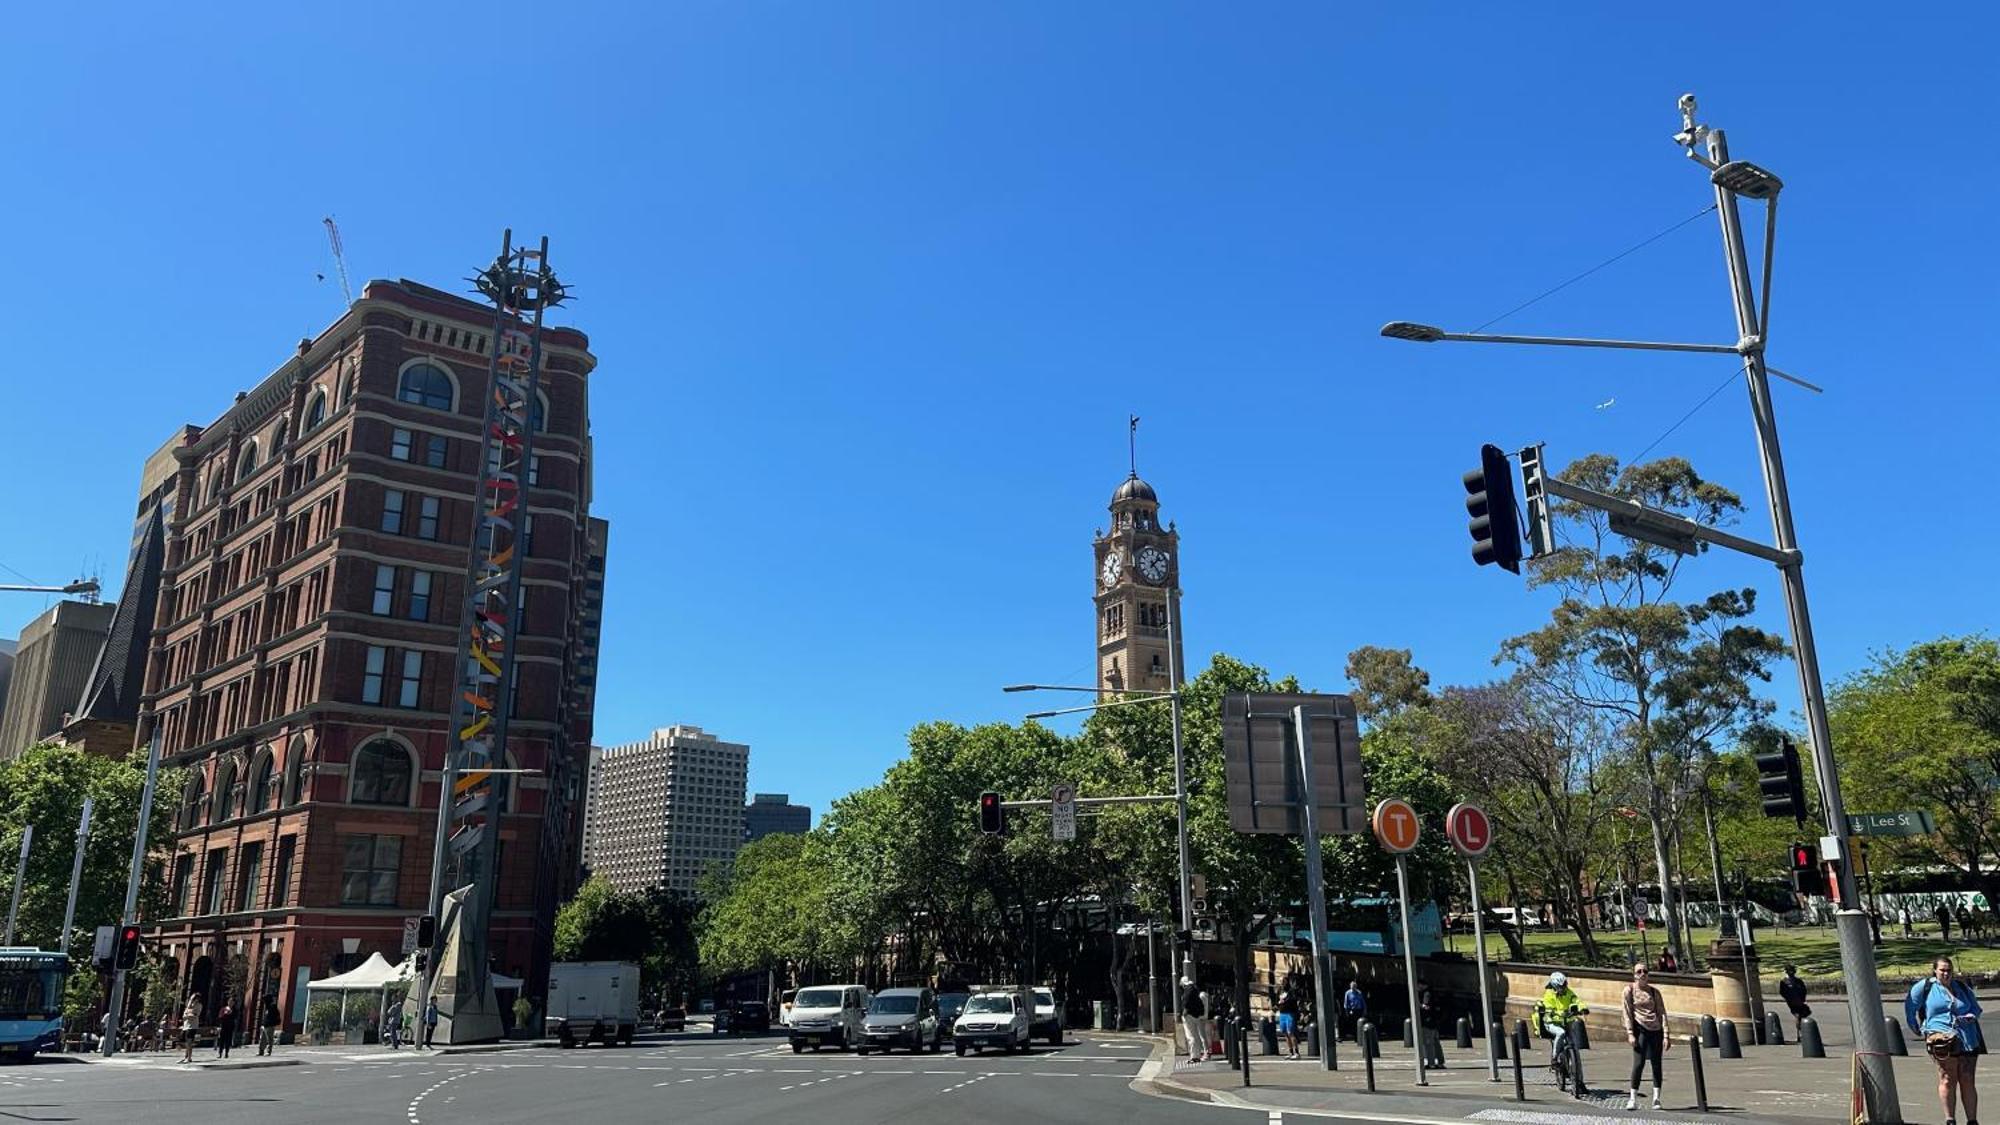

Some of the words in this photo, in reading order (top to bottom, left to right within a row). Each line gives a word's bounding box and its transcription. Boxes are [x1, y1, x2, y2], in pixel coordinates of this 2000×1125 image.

[1389, 813, 1408, 842] T
[1464, 814, 1481, 843] L
[1870, 815, 1895, 827] Lee
[1898, 813, 1910, 826] St
[1902, 893, 1969, 909] MURRAYS
